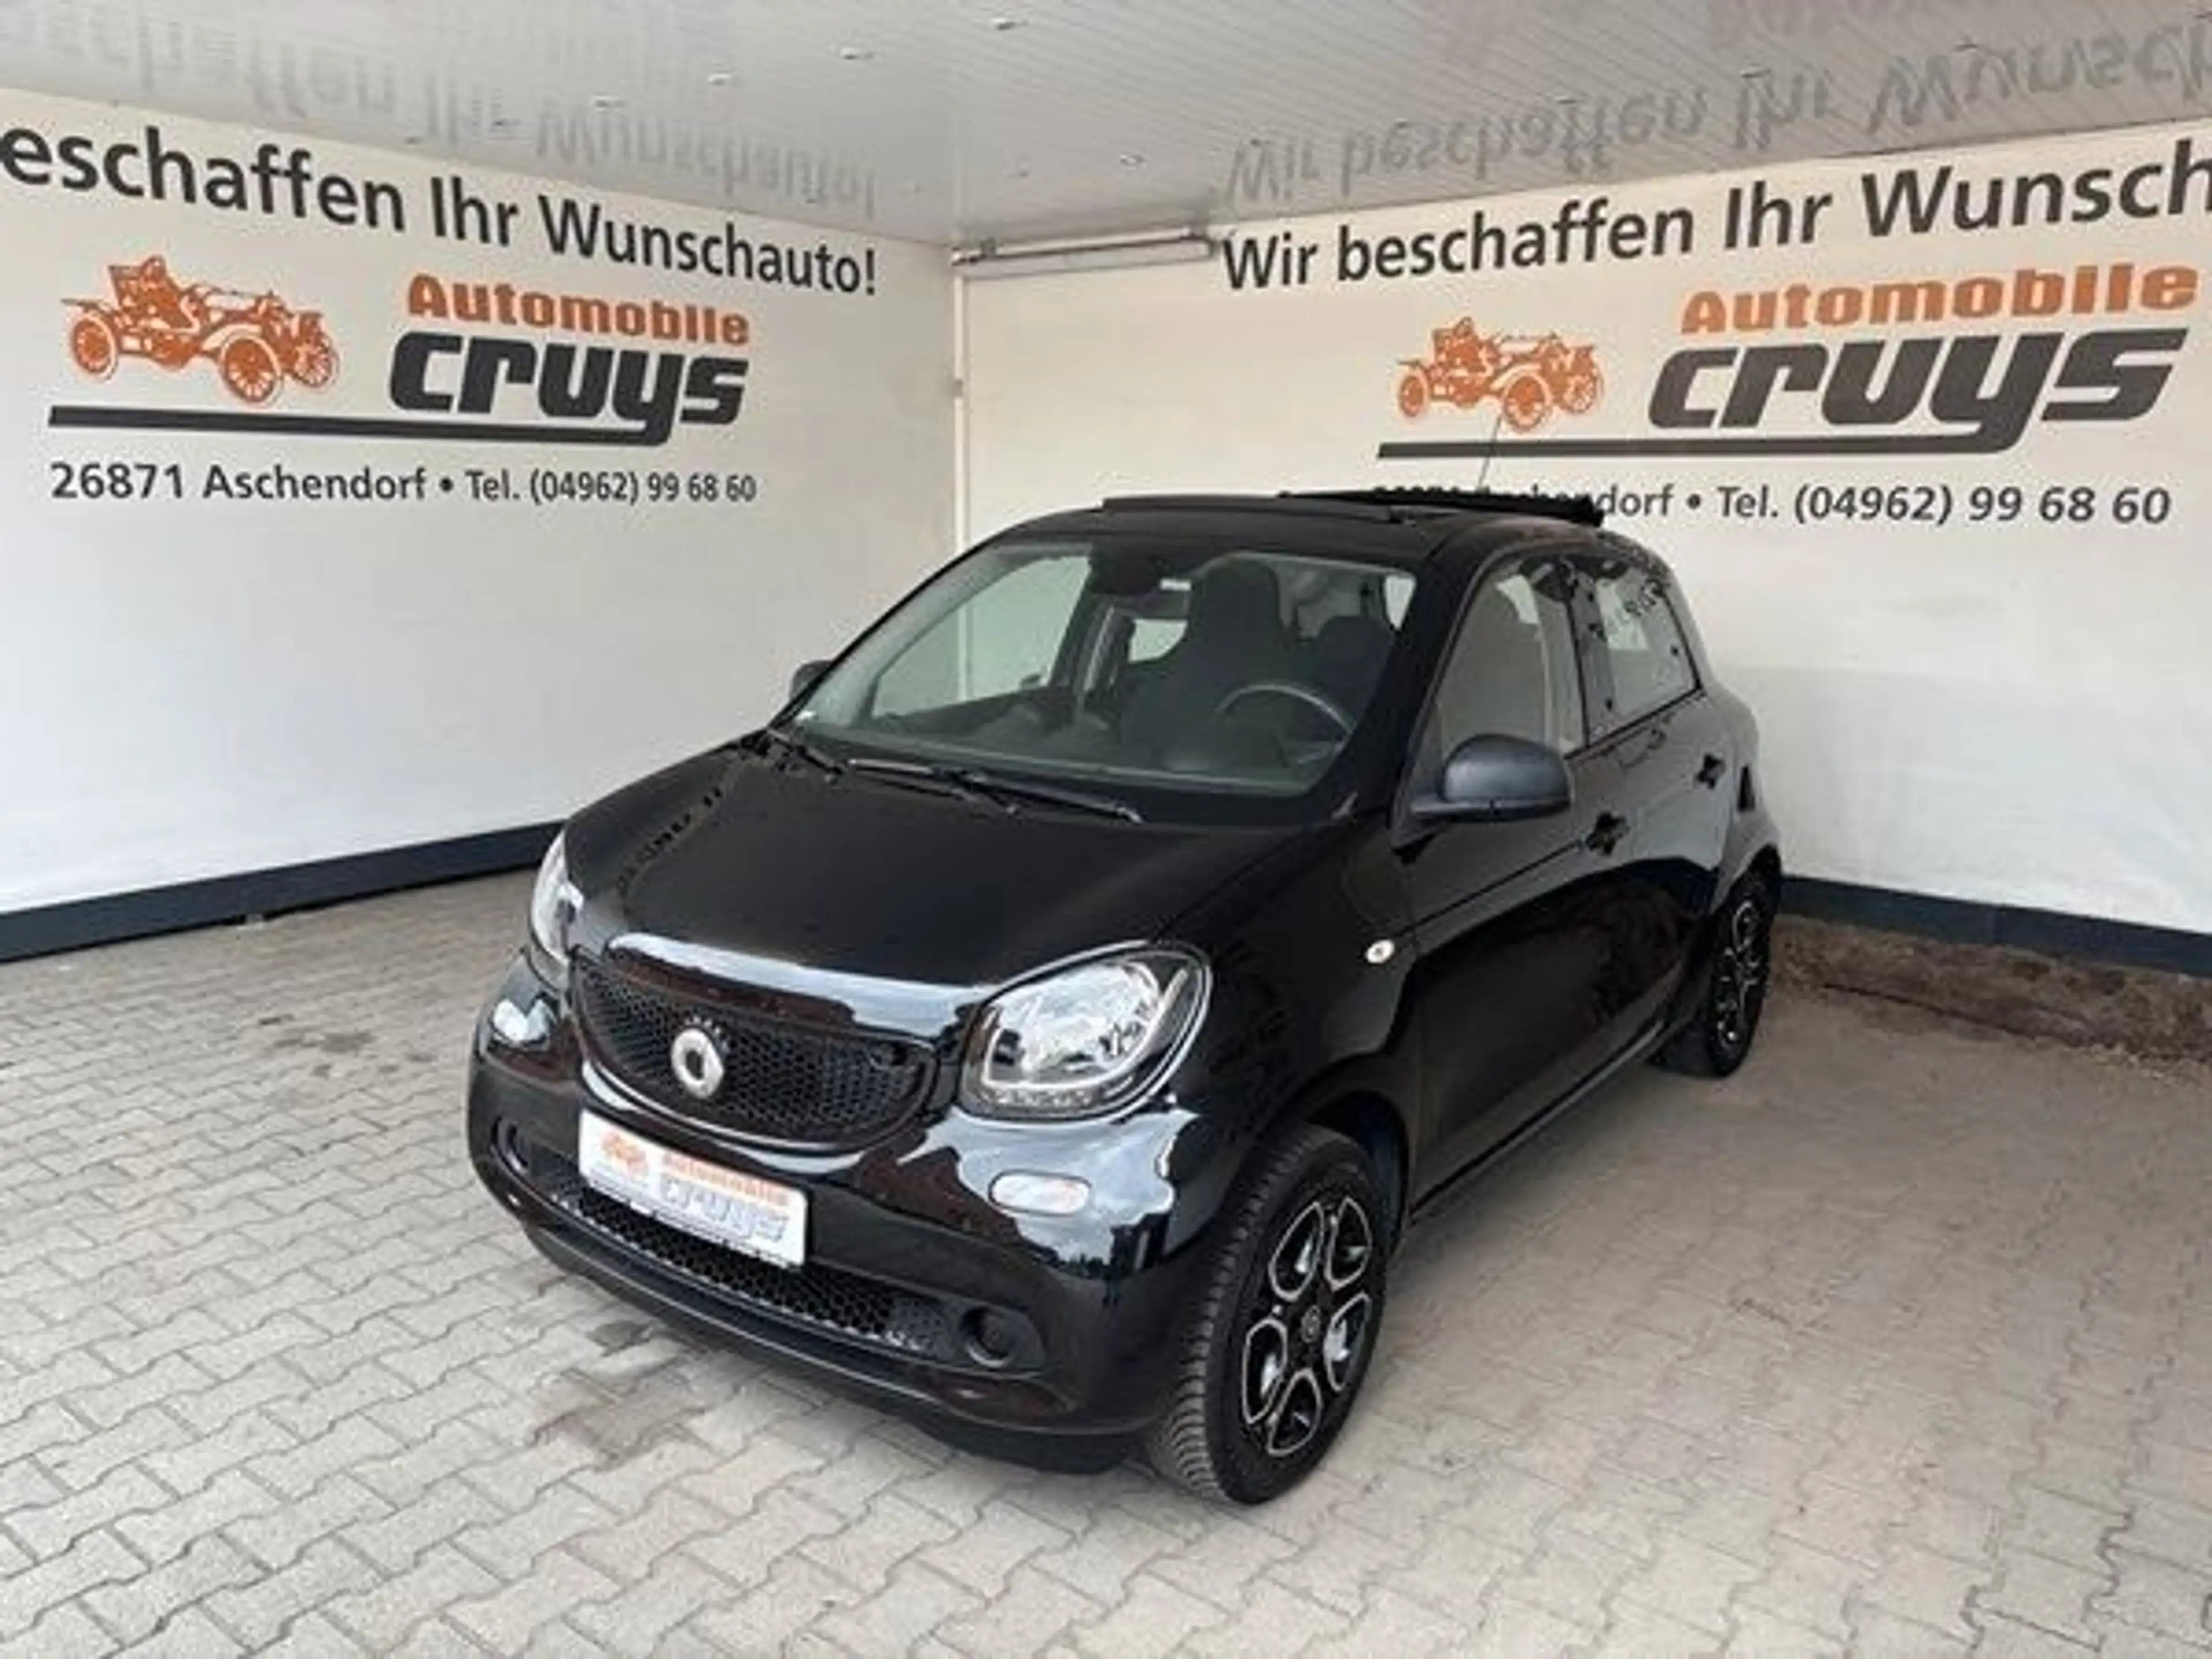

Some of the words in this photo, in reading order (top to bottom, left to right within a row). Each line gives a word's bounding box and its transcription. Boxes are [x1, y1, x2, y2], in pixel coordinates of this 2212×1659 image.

[0, 126, 405, 232] eschaffen
[431, 176, 518, 247] Ihr
[539, 195, 876, 295] Wunschauto!
[1222, 232, 1318, 290] Wir
[1338, 196, 1694, 282] beschaffen
[1725, 180, 1832, 249] Ihr
[1861, 137, 2212, 237] Wunsch
[408, 273, 749, 346] Automobile
[1681, 263, 2198, 335] Automobile
[389, 331, 748, 447] cruys
[1648, 327, 2189, 454] cruys
[51, 461, 183, 499] 26871
[203, 464, 426, 500] Aschendorf
[465, 468, 520, 501] Tel.
[530, 468, 639, 506] (04962)
[647, 472, 680, 502] 99
[688, 473, 718, 502] 68
[726, 474, 757, 502] 60
[1717, 484, 1779, 518] Tel.
[1794, 484, 1953, 527] (04962)
[1968, 486, 2023, 522] 99
[2038, 486, 2096, 523] 68
[2111, 487, 2172, 525] 60
